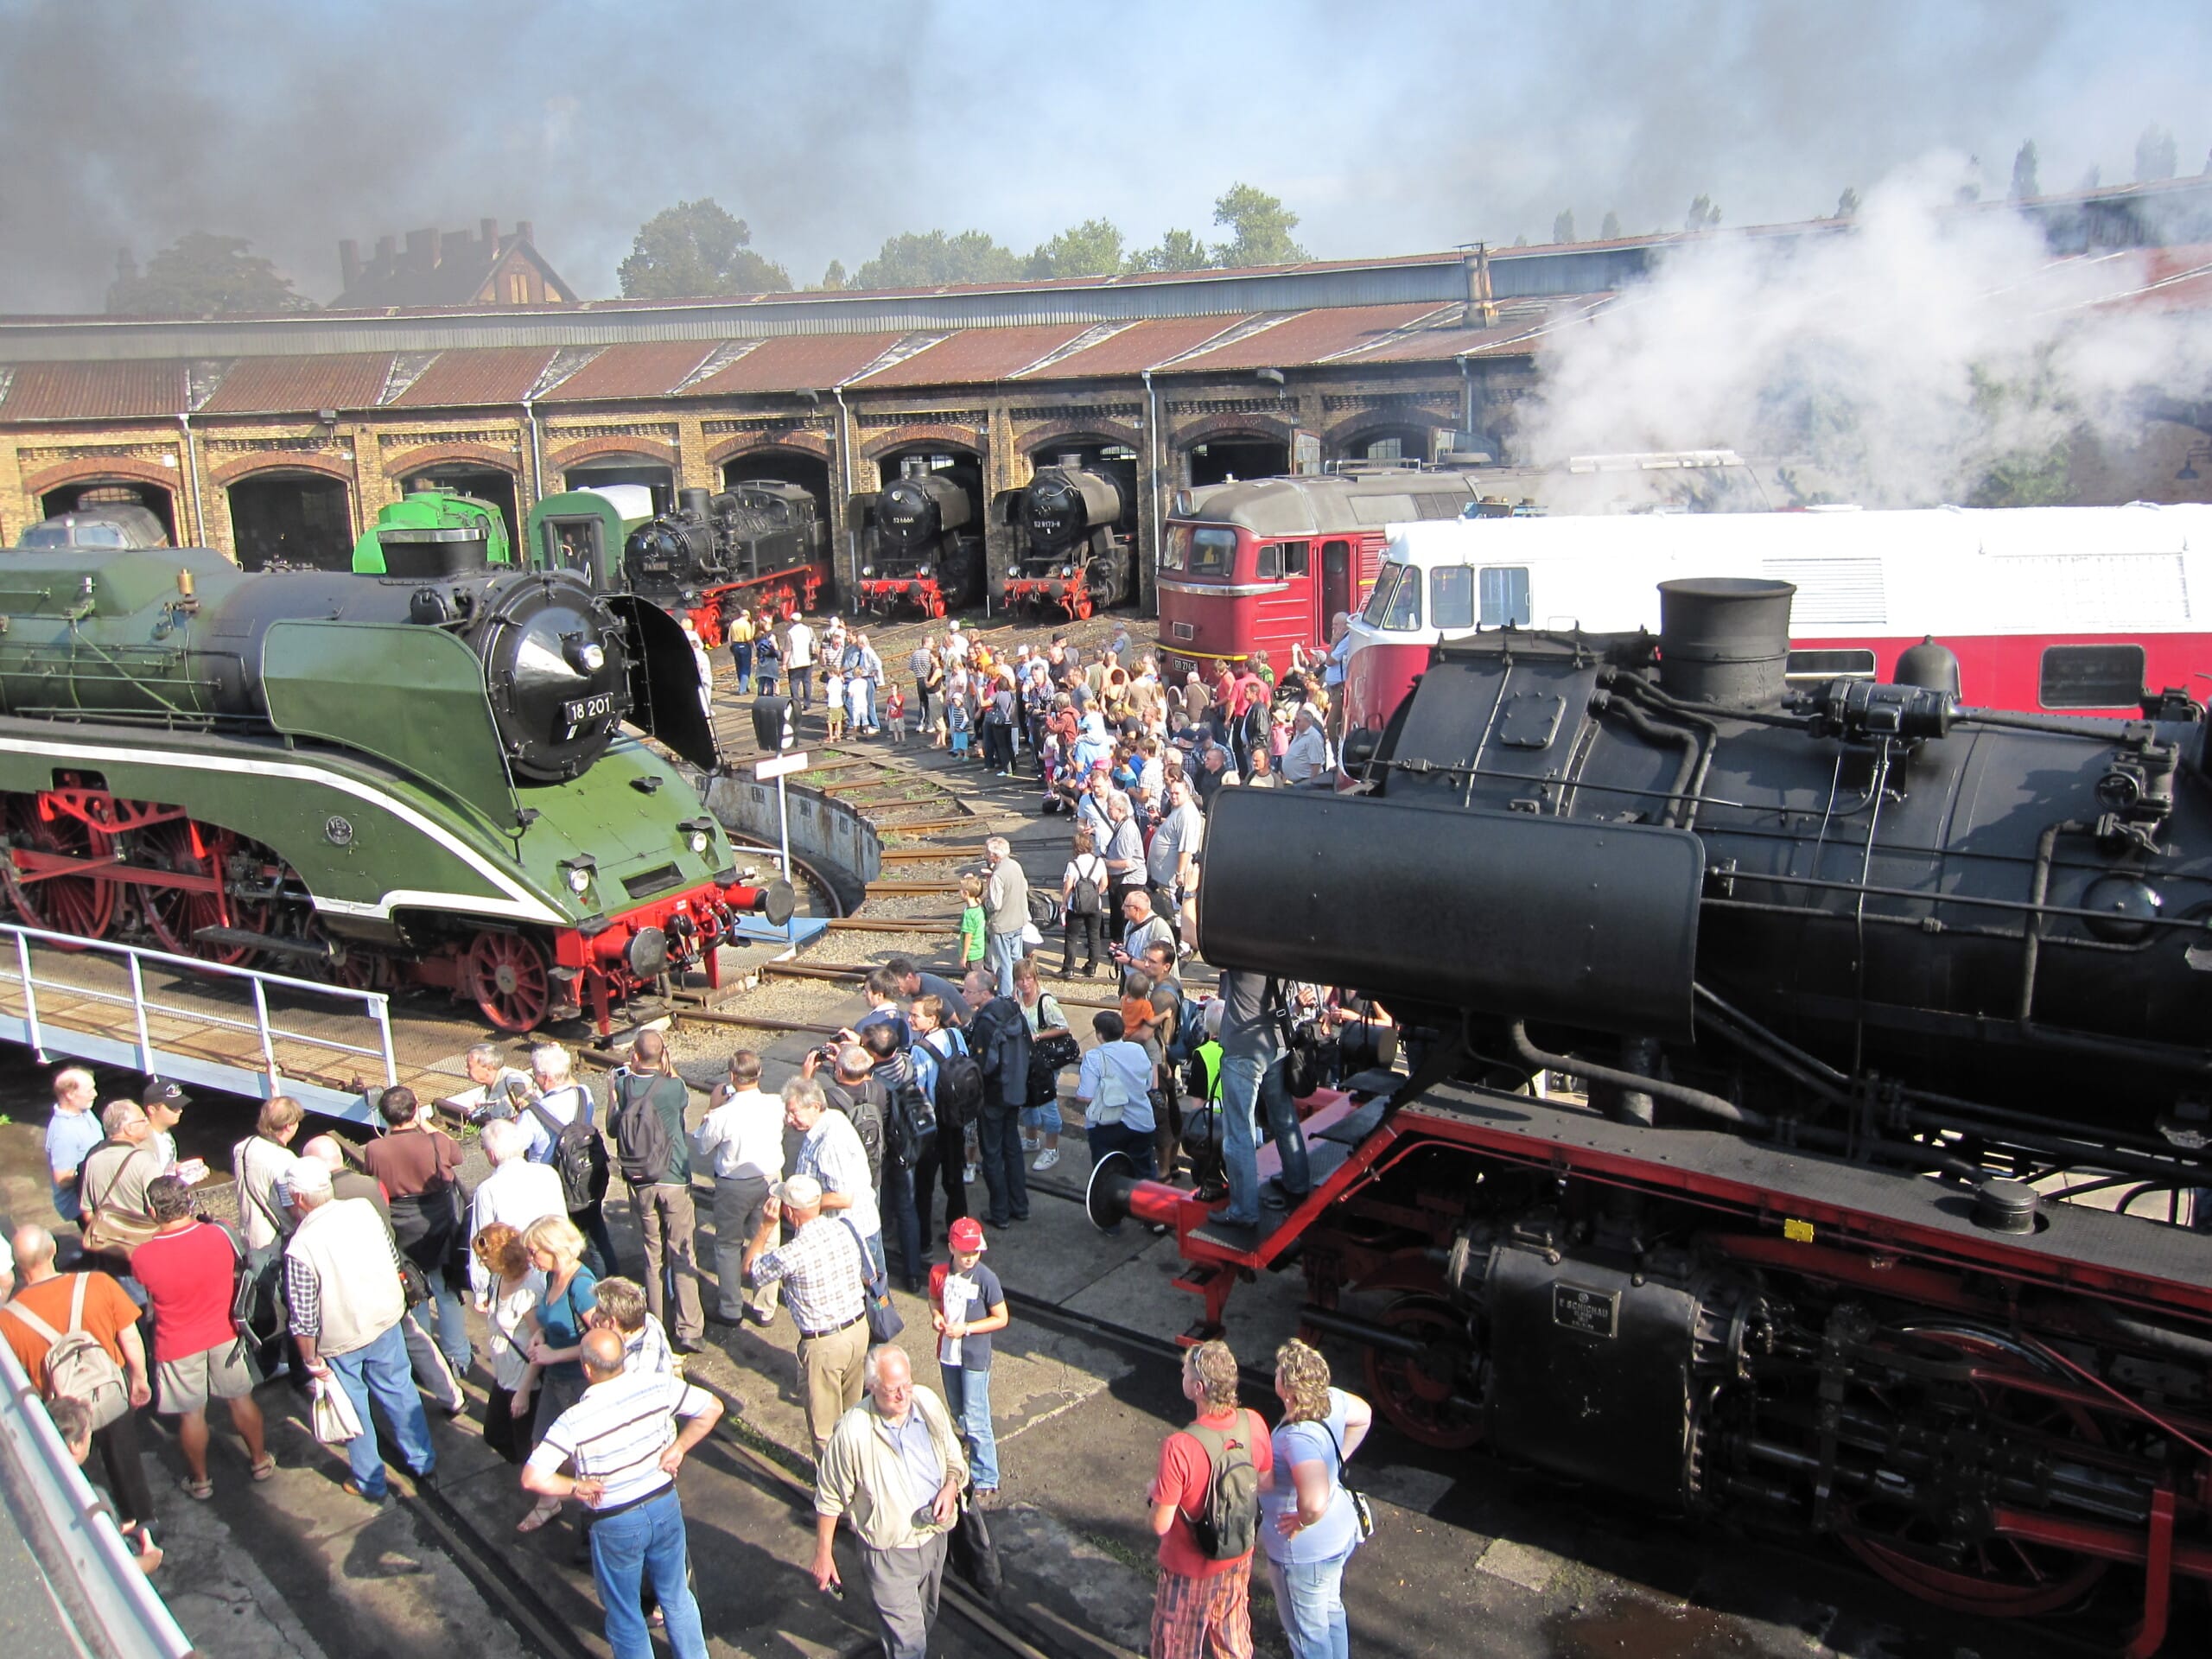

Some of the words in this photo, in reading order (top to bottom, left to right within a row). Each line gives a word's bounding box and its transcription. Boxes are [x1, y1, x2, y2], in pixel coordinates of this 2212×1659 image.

[571, 703, 585, 721] 18
[588, 697, 610, 716] 201
[1567, 1300, 1608, 1318] SCHICHAU
